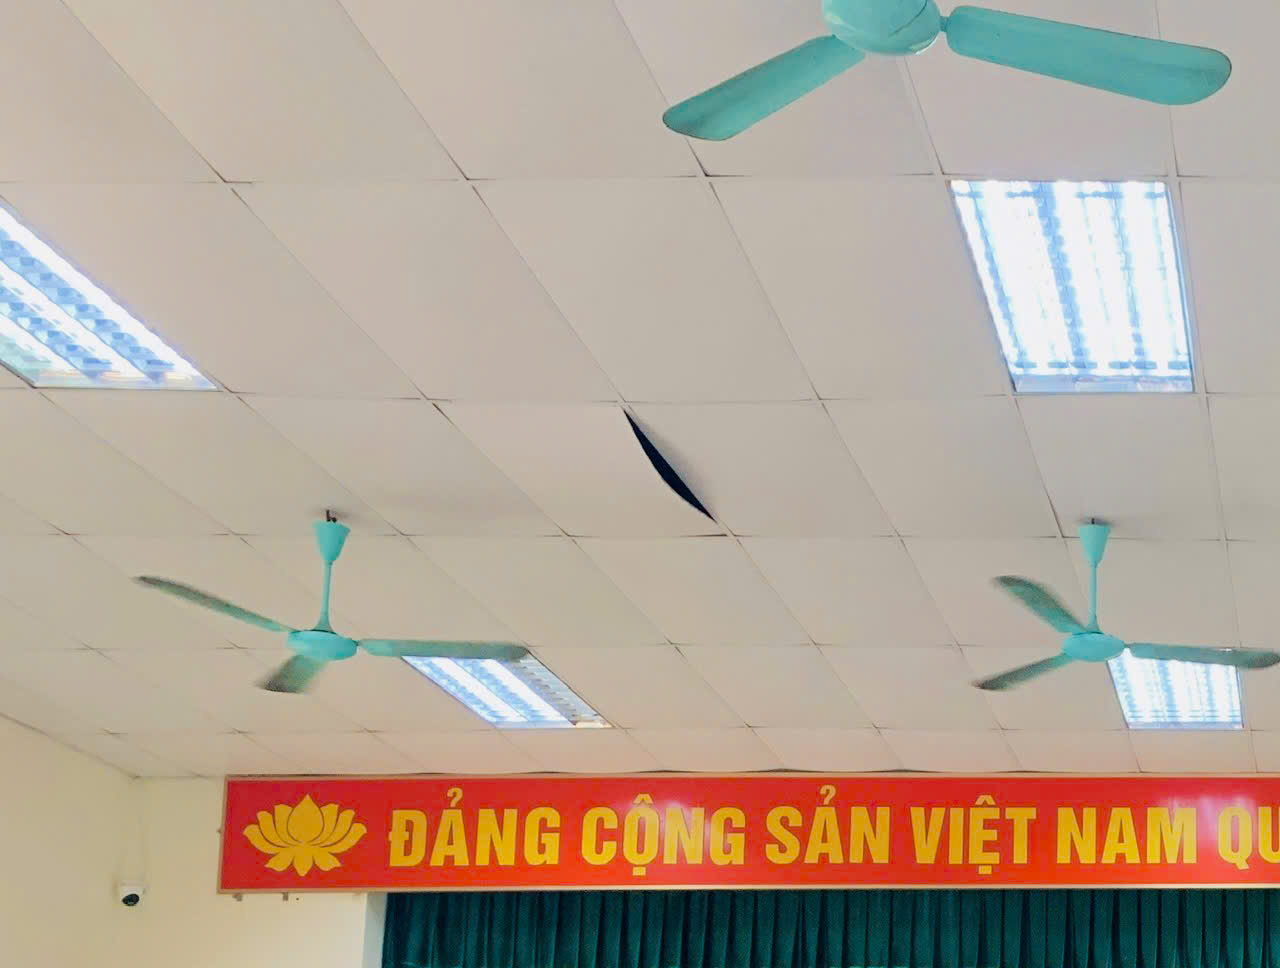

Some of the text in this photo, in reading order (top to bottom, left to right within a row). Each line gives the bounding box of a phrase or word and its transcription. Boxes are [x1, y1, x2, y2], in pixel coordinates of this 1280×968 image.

[388, 787, 560, 867] ĐẢNG
[581, 793, 745, 876] CỘNG
[765, 784, 890, 864] SẢN
[910, 795, 1036, 875] VIỆT
[1056, 807, 1197, 864] NAM
